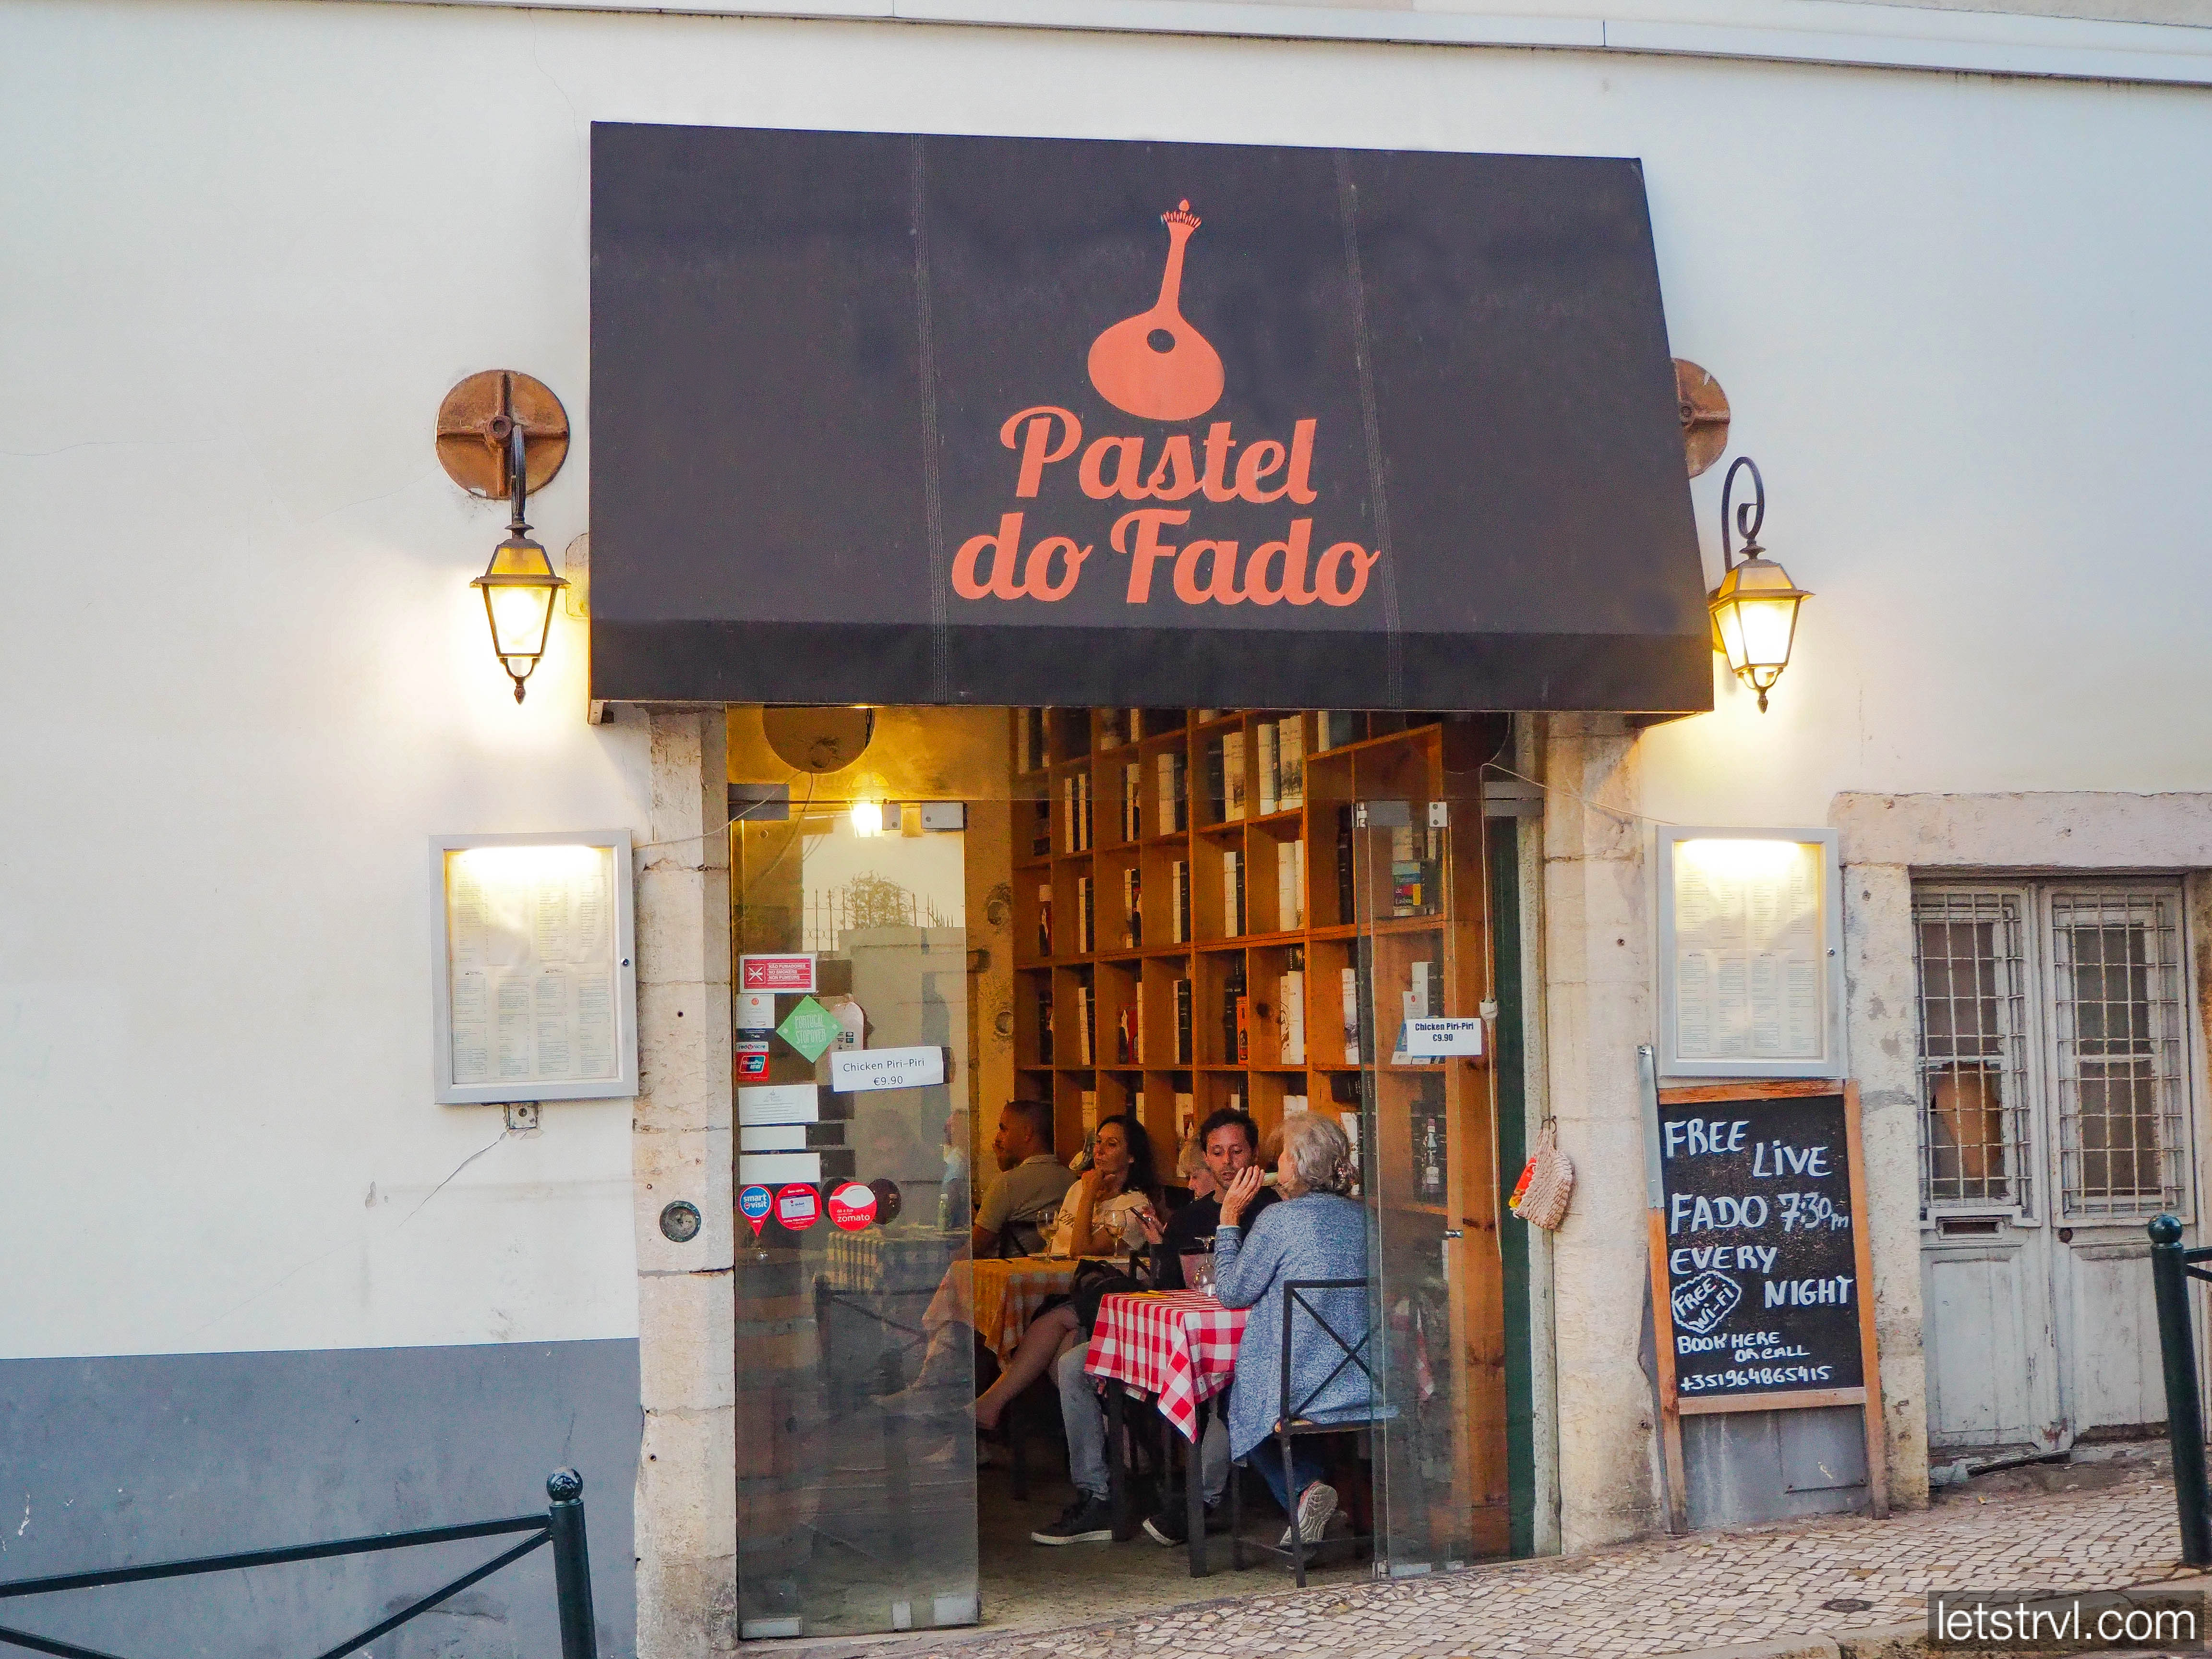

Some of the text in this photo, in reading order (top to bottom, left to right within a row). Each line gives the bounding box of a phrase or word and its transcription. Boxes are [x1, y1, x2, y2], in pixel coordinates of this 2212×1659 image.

[1000, 405, 1317, 505] Pastel
[951, 508, 1381, 607] do Fado
[1433, 1034, 1453, 1042] €9.90
[843, 1058, 925, 1072] Chicken Piri-Piri
[874, 1076, 903, 1086] €9.90
[1664, 1118, 1750, 1158] FREE
[744, 1194, 767, 1202] smart
[837, 1214, 870, 1222] zomato
[1671, 1192, 1768, 1234] FADO
[1670, 1245, 1778, 1274] EVERY
[1674, 1277, 1717, 1317] FREE
[1765, 1275, 1854, 1308] NIGHT
[1677, 1332, 1780, 1354] BOOK HERE
[1681, 1366, 1833, 1391] +351964865415
